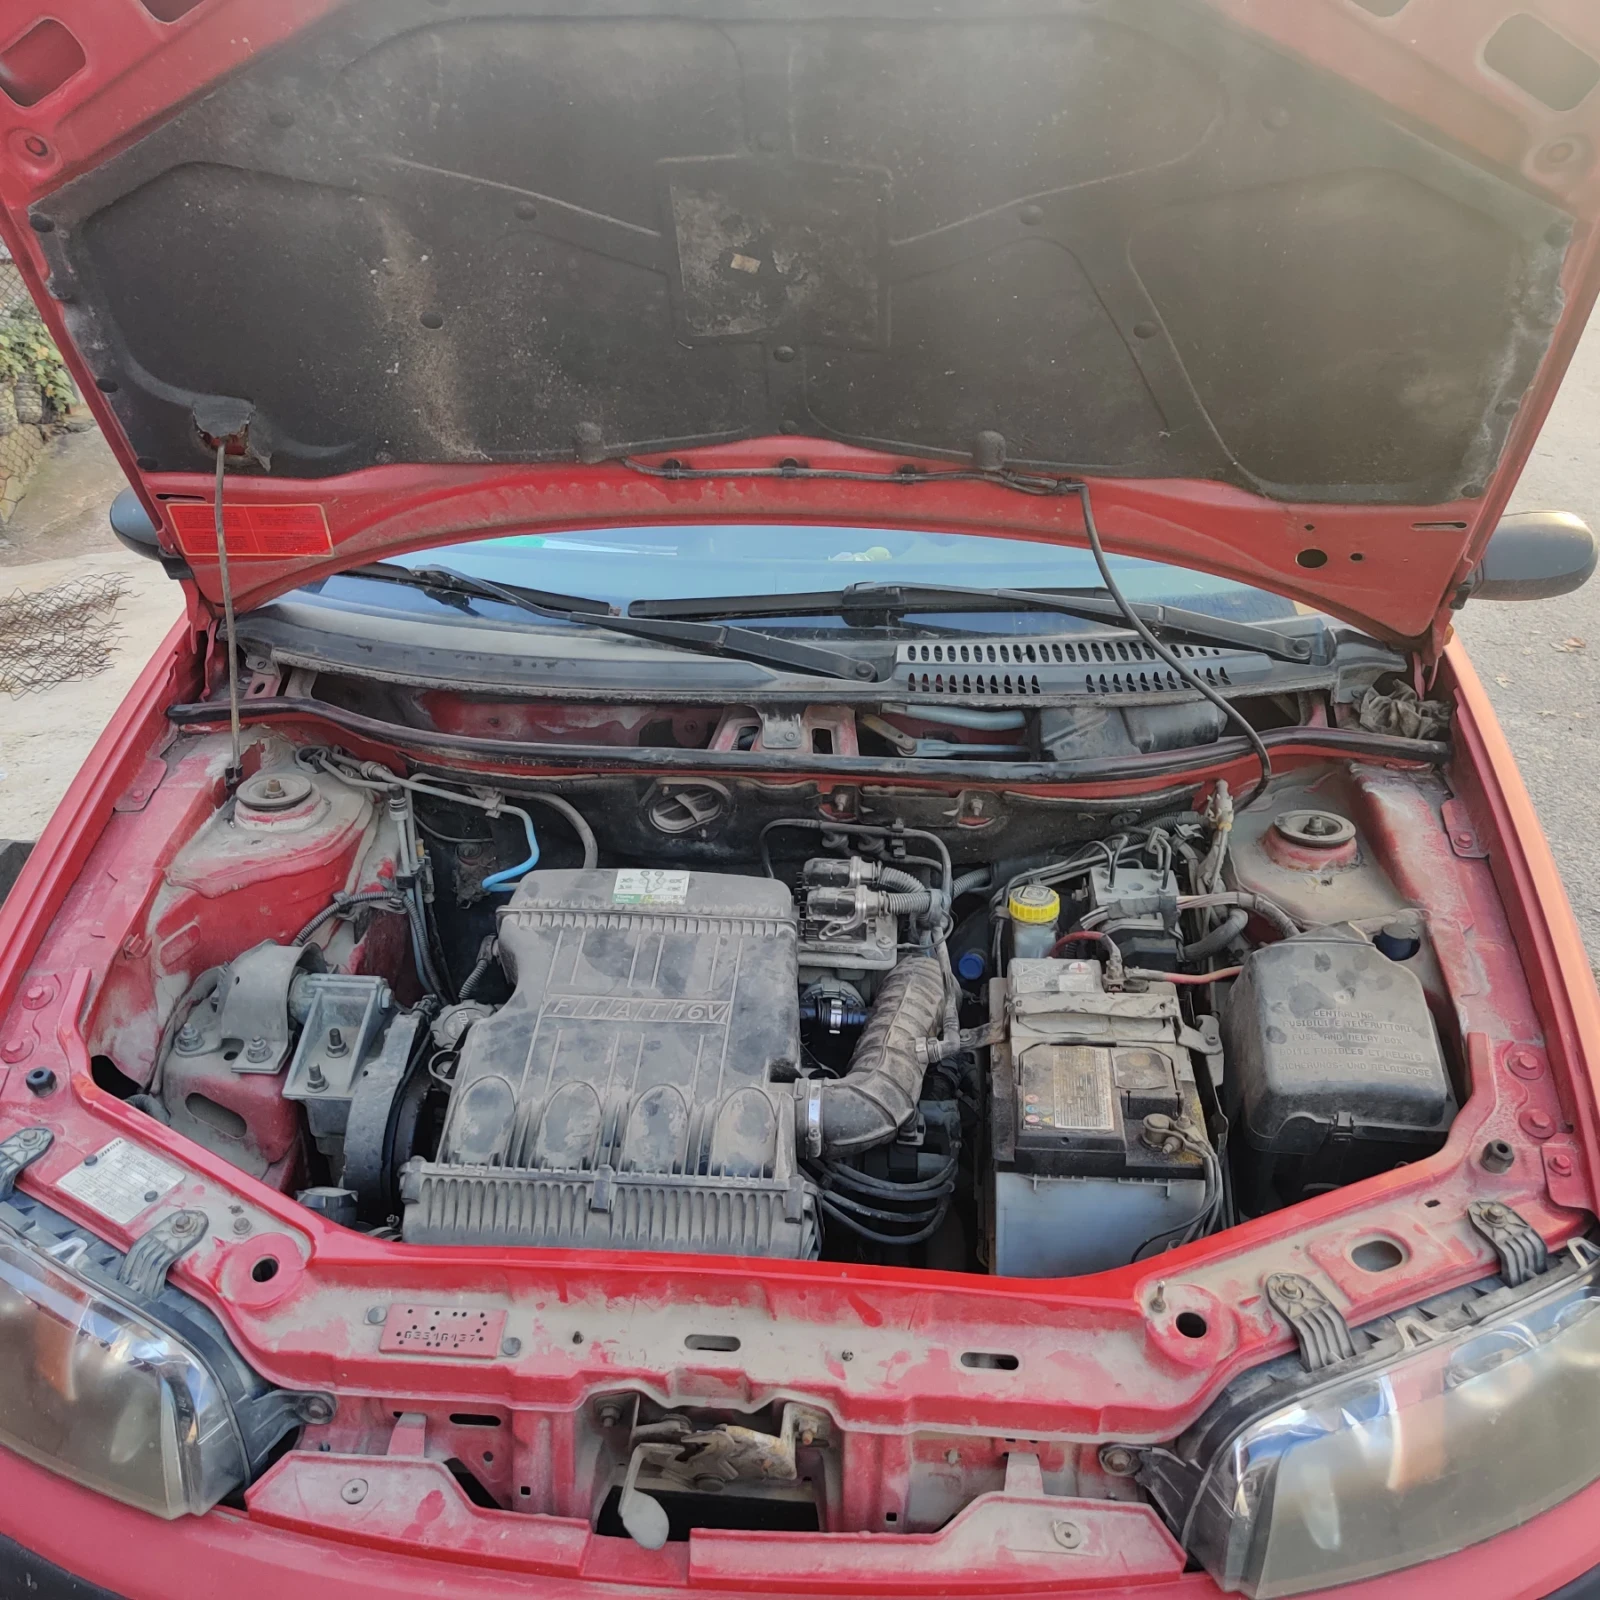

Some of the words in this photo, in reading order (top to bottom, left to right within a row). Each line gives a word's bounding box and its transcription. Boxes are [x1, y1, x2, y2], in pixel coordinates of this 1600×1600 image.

[553, 998, 666, 1019] FIAT
[673, 1003, 726, 1020] 16V
[1313, 1010, 1374, 1019] CENTRALINA
[1323, 1033, 1343, 1041] AND
[1348, 1034, 1379, 1042] RELAY
[1384, 1036, 1403, 1045] BOX
[1314, 1047, 1364, 1056] FUSIBLES
[1386, 1050, 1422, 1061] RELAIS
[1347, 1062, 1367, 1070] UND
